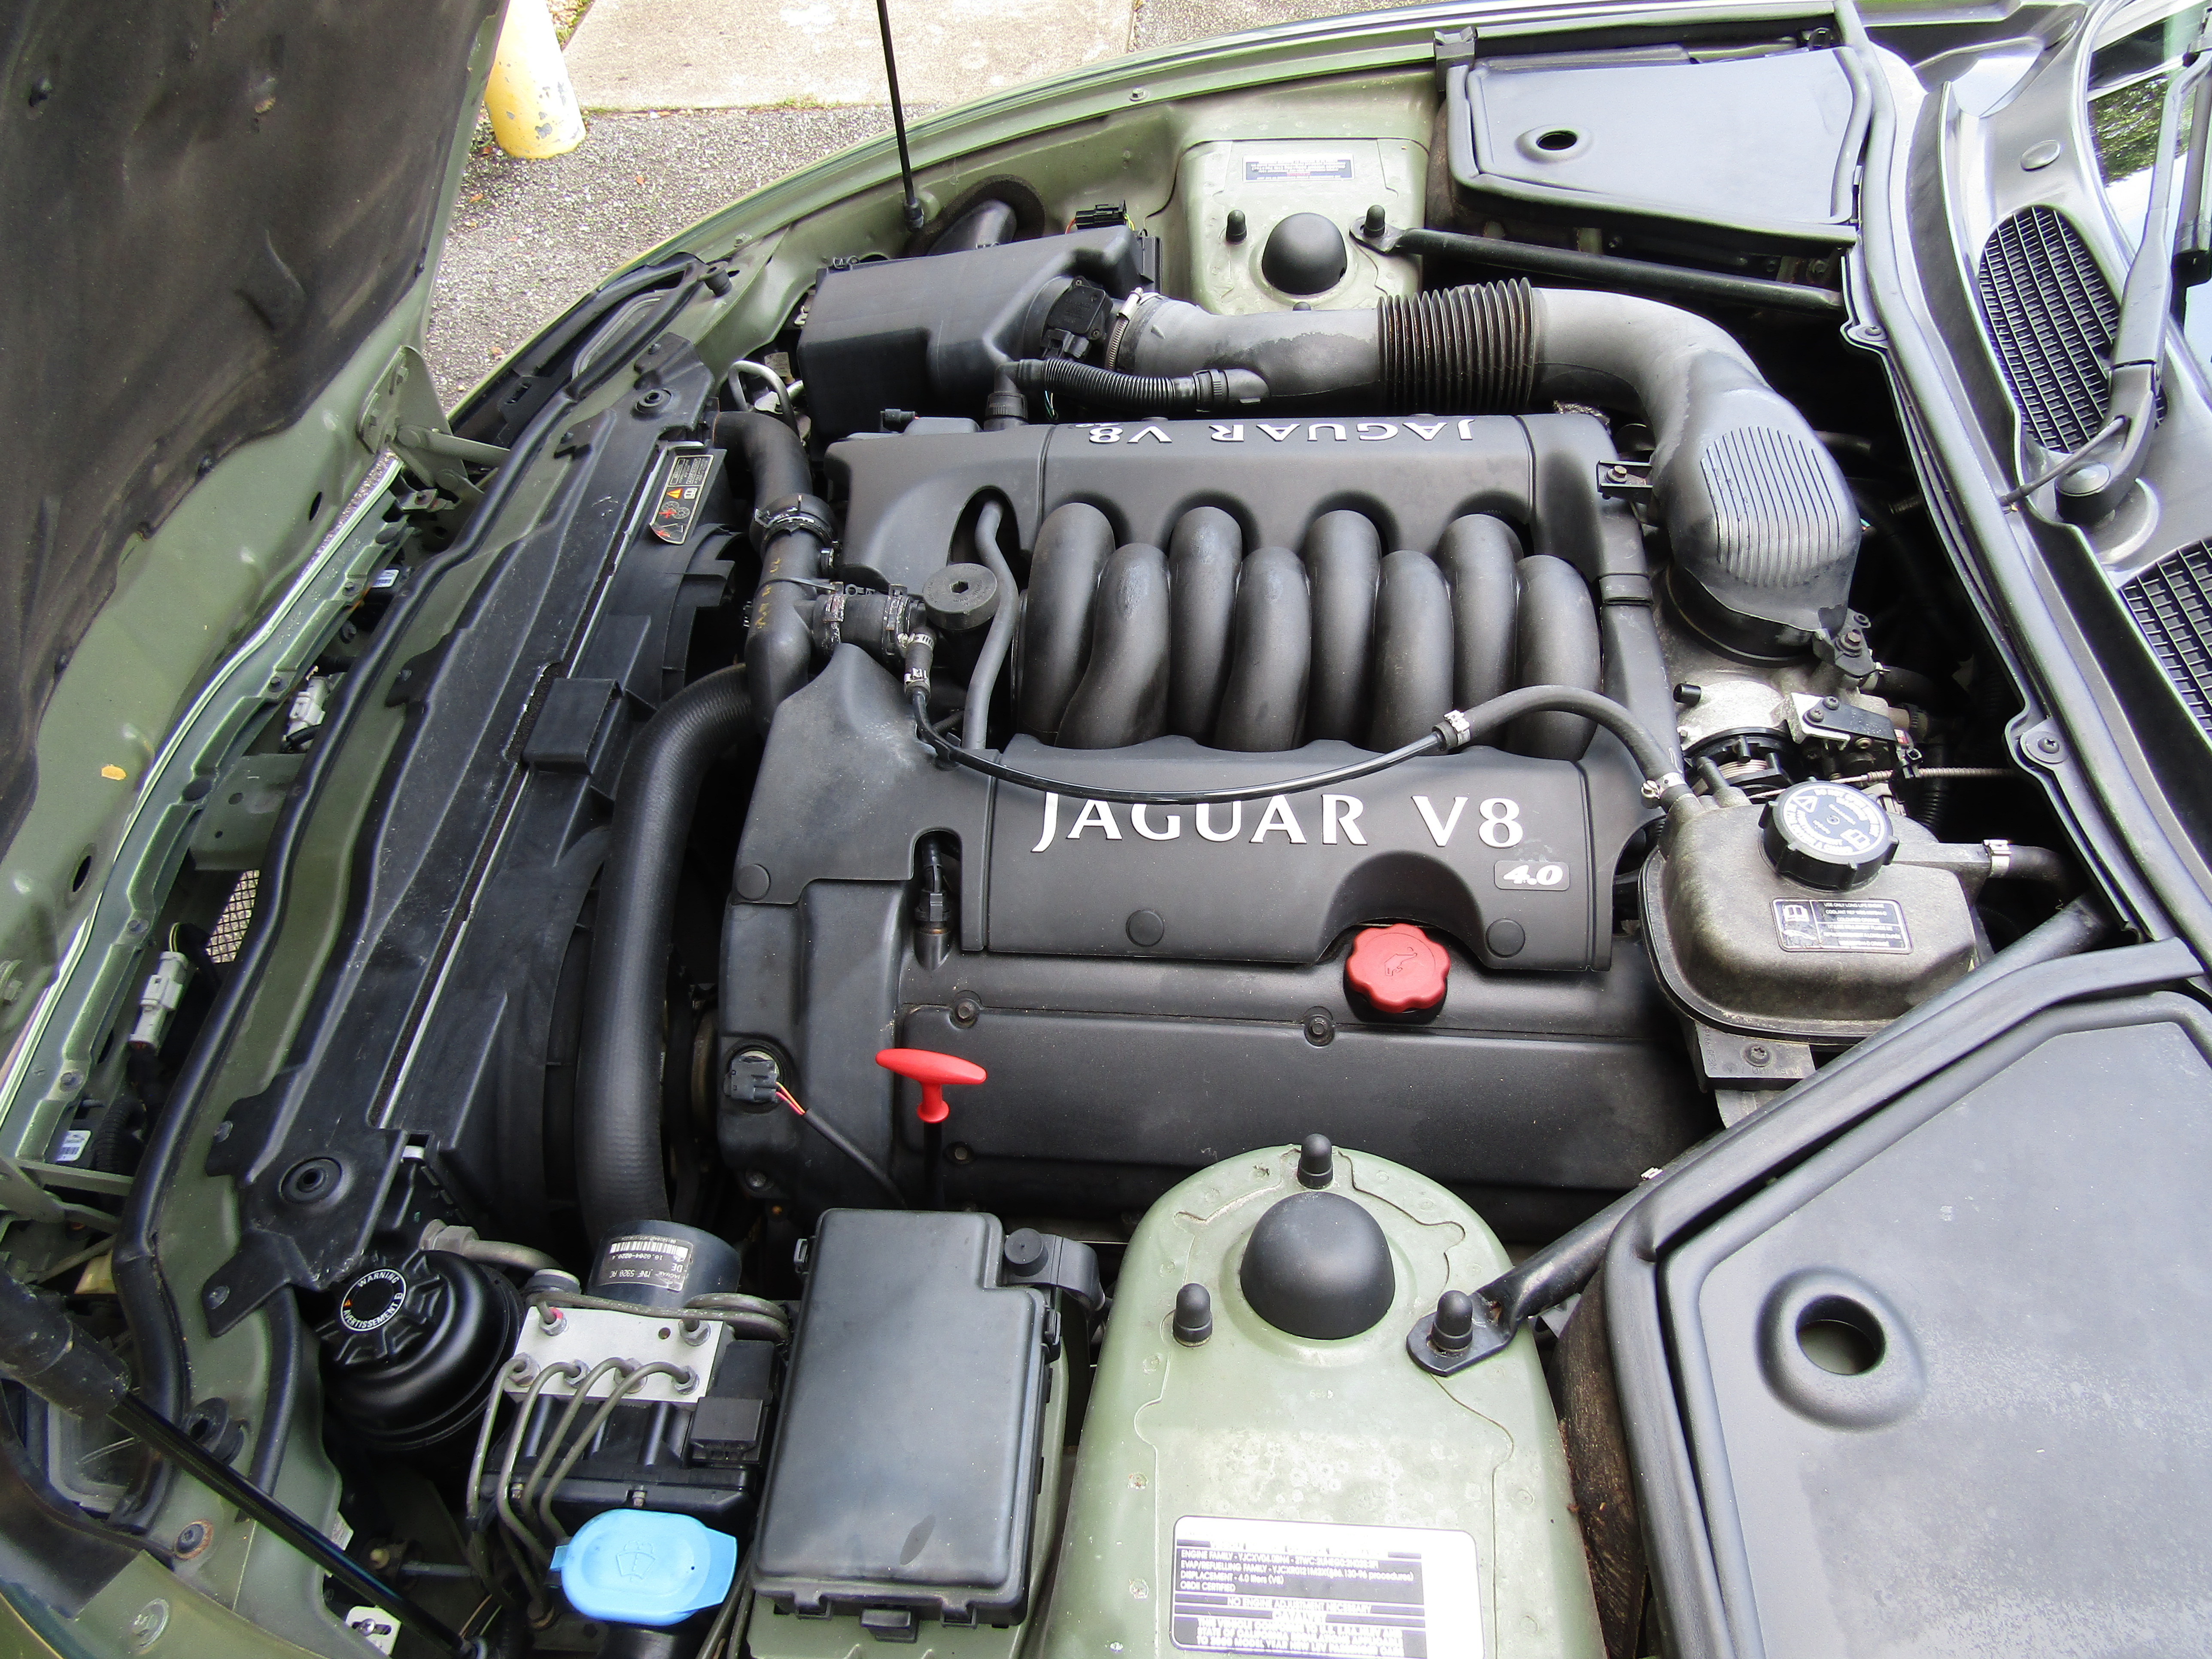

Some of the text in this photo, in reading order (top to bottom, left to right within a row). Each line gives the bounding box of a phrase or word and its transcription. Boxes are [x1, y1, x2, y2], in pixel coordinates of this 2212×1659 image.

[1089, 419, 1474, 443] JAGUAR V8
[1030, 793, 1524, 853] JAGUAR V8
[1503, 865, 1563, 886] 4.0
[638, 1269, 651, 1278] MNF
[671, 1263, 684, 1273] DE
[357, 1271, 400, 1288] WARNING
[659, 1270, 681, 1279] JAGUAR
[343, 1301, 399, 1329] AVERTISSEMENT
[1181, 1550, 1207, 1559] ENGINE
[1209, 1551, 1233, 1561] FAMILY
[1181, 1560, 1242, 1571] EVAP/REFUELLING
[1243, 1563, 1267, 1573] FAMILY
[1180, 1570, 1233, 1582] DISPLACEMENT
[1238, 1574, 1249, 1582] 4.0
[1201, 1581, 1236, 1592] CERTIFIED
[1227, 1596, 1241, 1606] NO
[1242, 1597, 1273, 1608] ENGINE
[1197, 1635, 1209, 1645] TO
